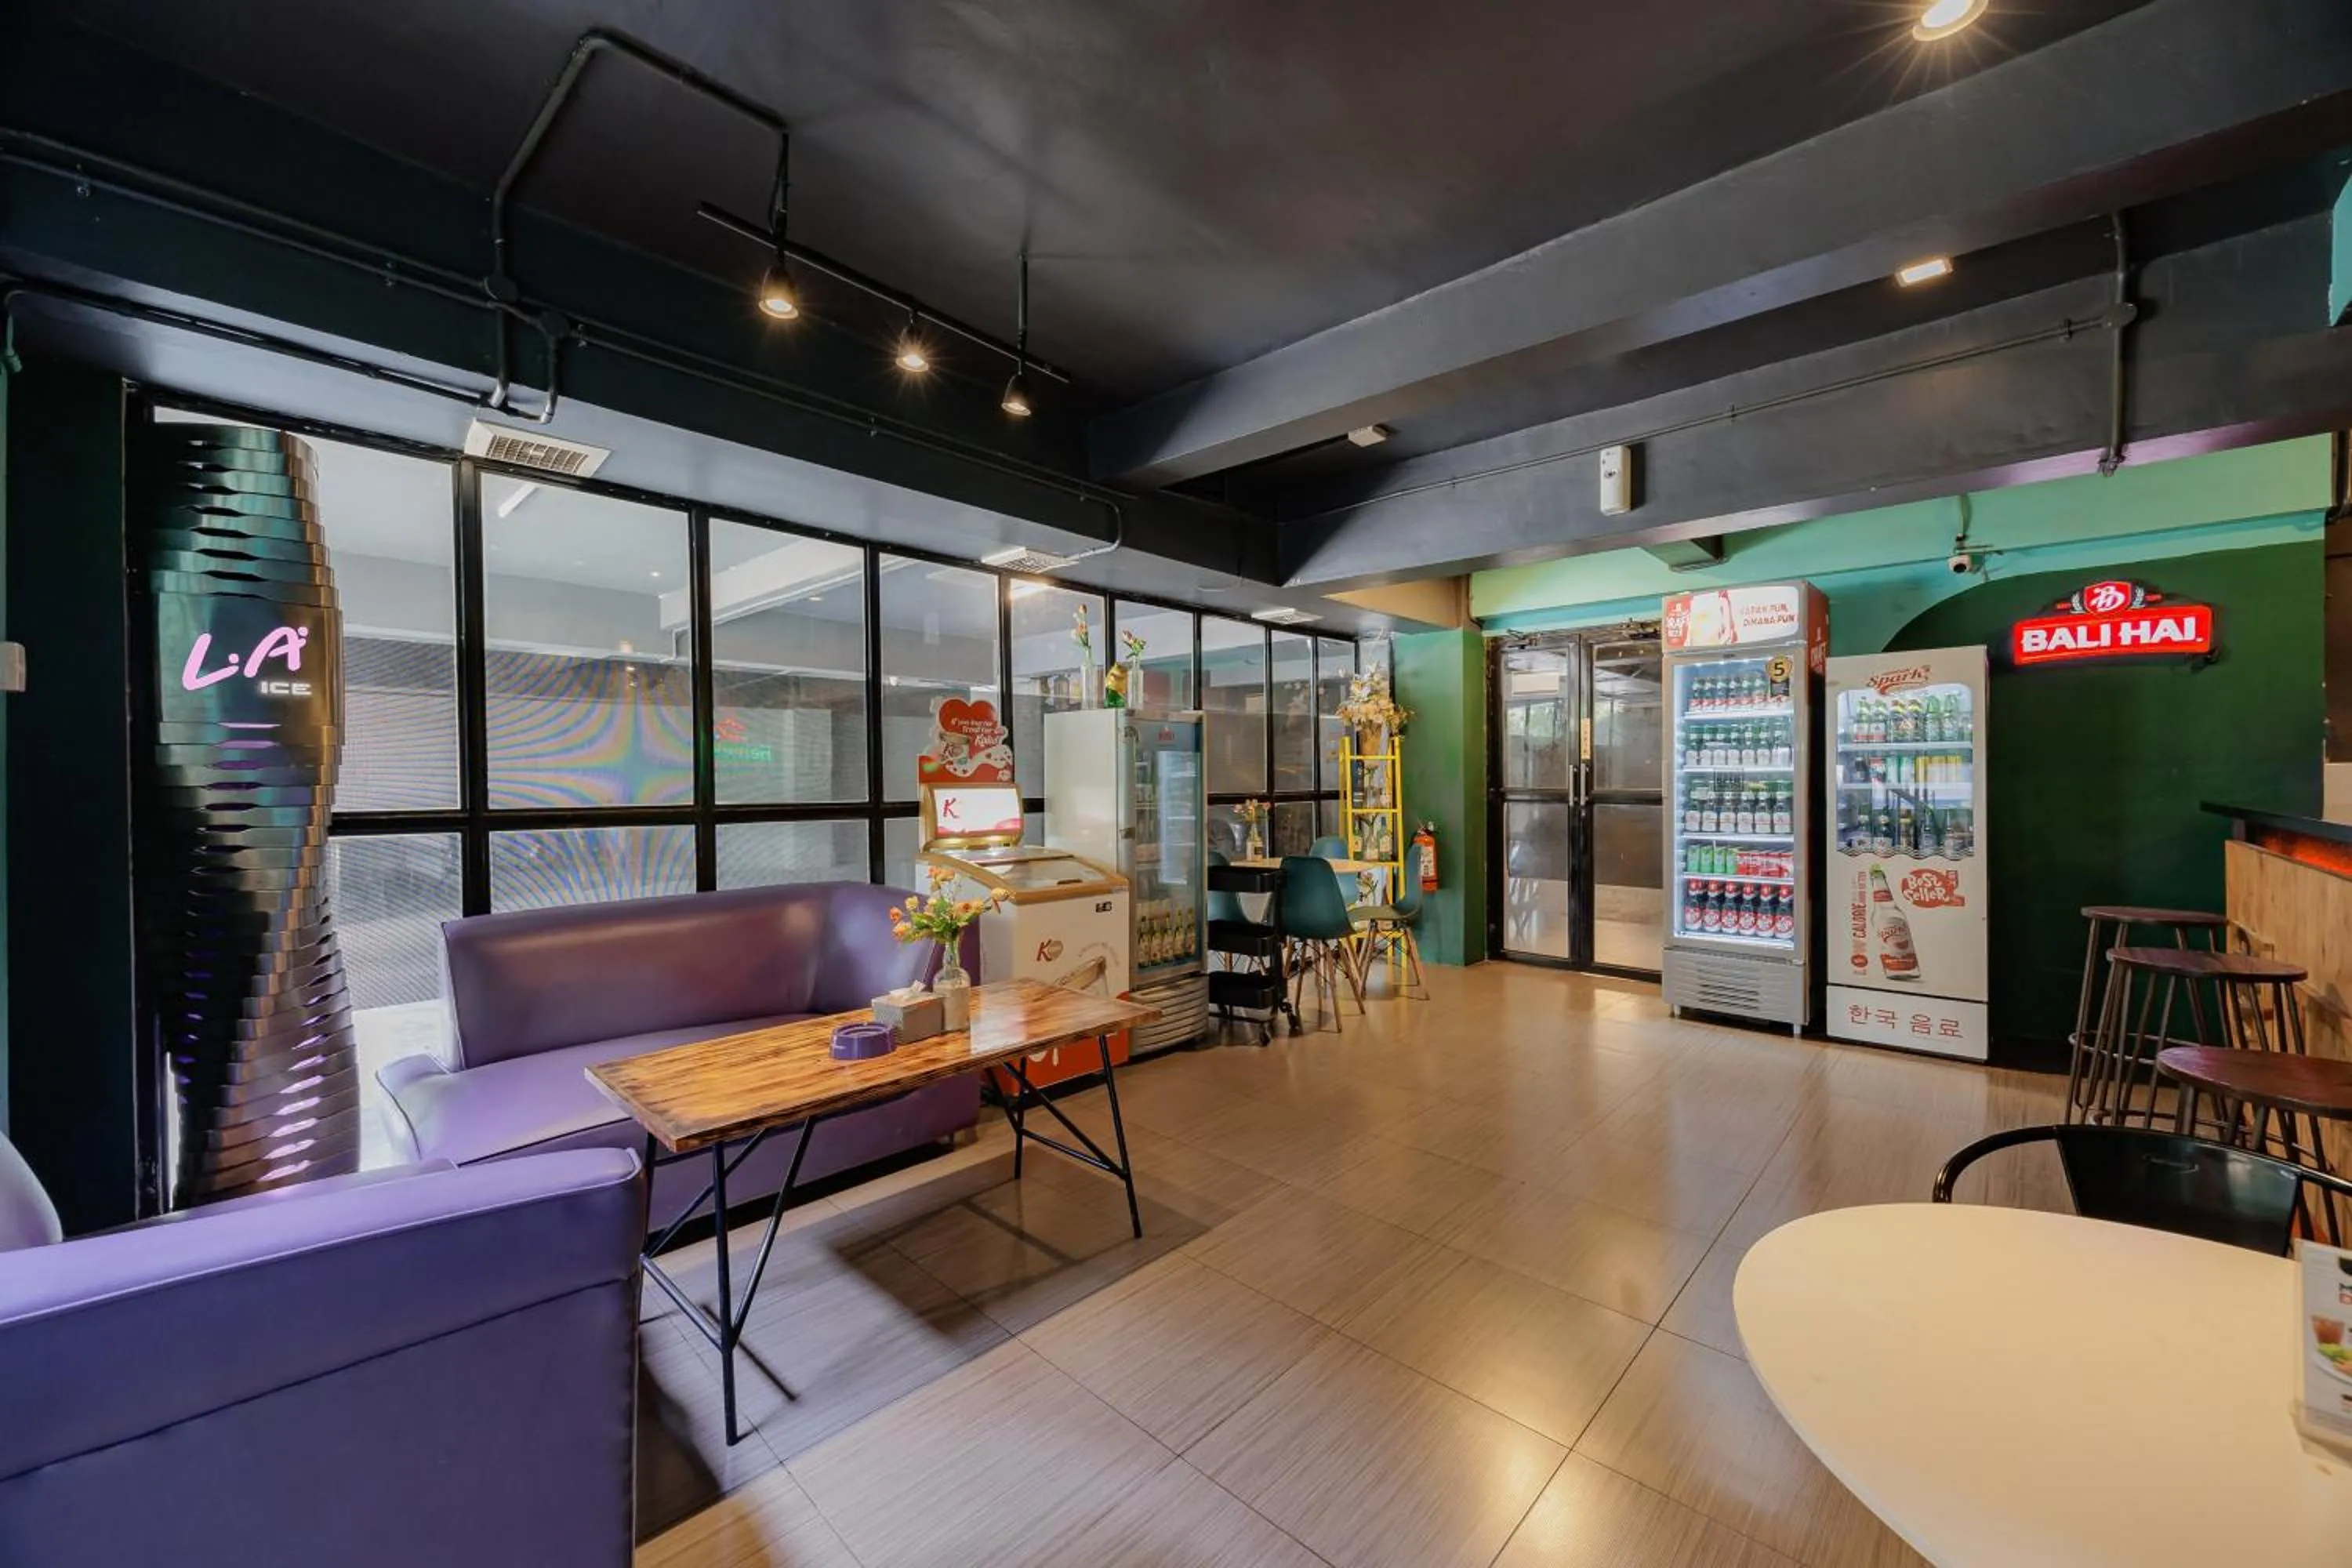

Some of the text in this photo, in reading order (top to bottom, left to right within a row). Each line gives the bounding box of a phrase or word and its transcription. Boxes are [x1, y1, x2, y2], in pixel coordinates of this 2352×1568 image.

[2022, 624, 2111, 652] BALI
[1774, 662, 1784, 676] 5
[260, 681, 312, 695] ICE
[1851, 903, 1866, 938] CALORIE
[1849, 1004, 1963, 1038] 한국 음료
